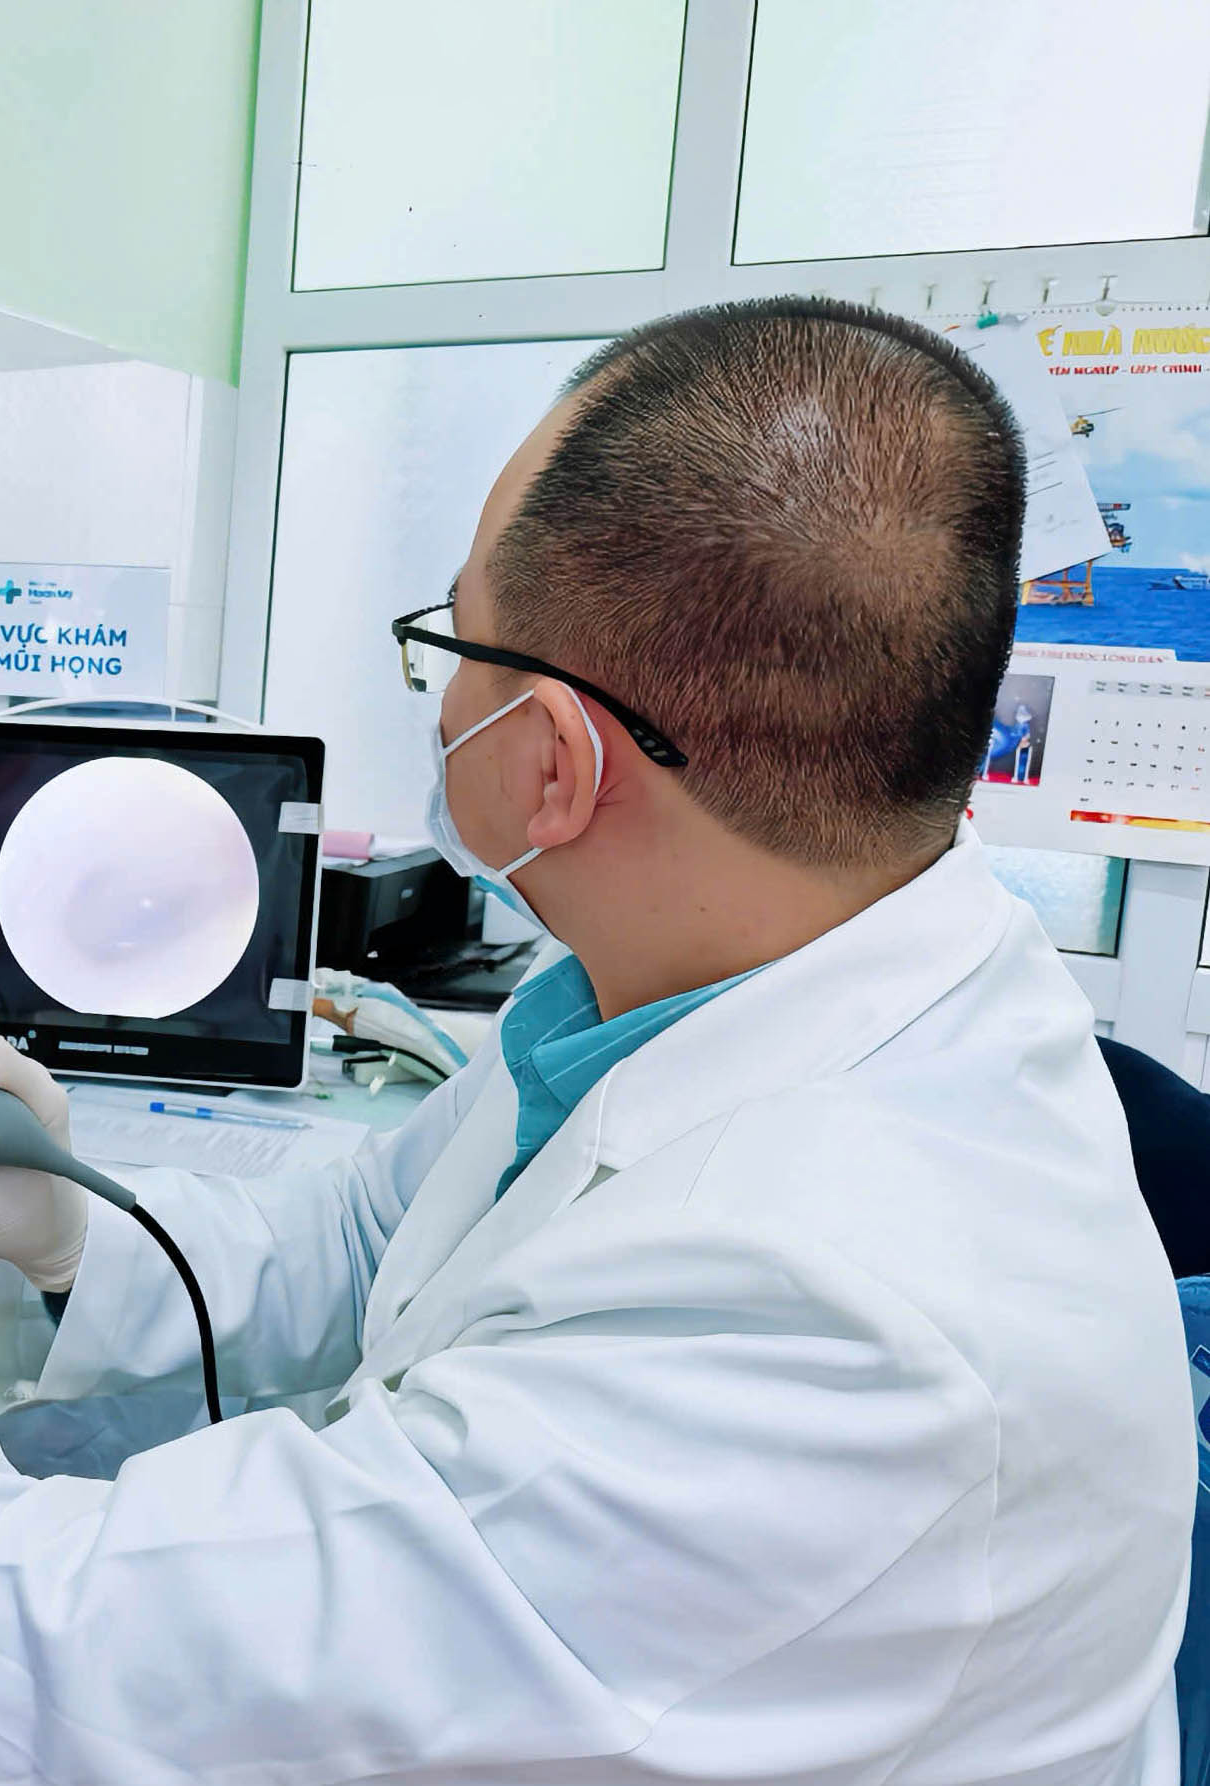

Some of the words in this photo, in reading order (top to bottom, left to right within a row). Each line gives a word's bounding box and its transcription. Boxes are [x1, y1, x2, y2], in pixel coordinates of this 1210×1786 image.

[0, 623, 48, 648] VỰC
[58, 624, 127, 647] KHÁM
[50, 655, 123, 678] HỌNG
